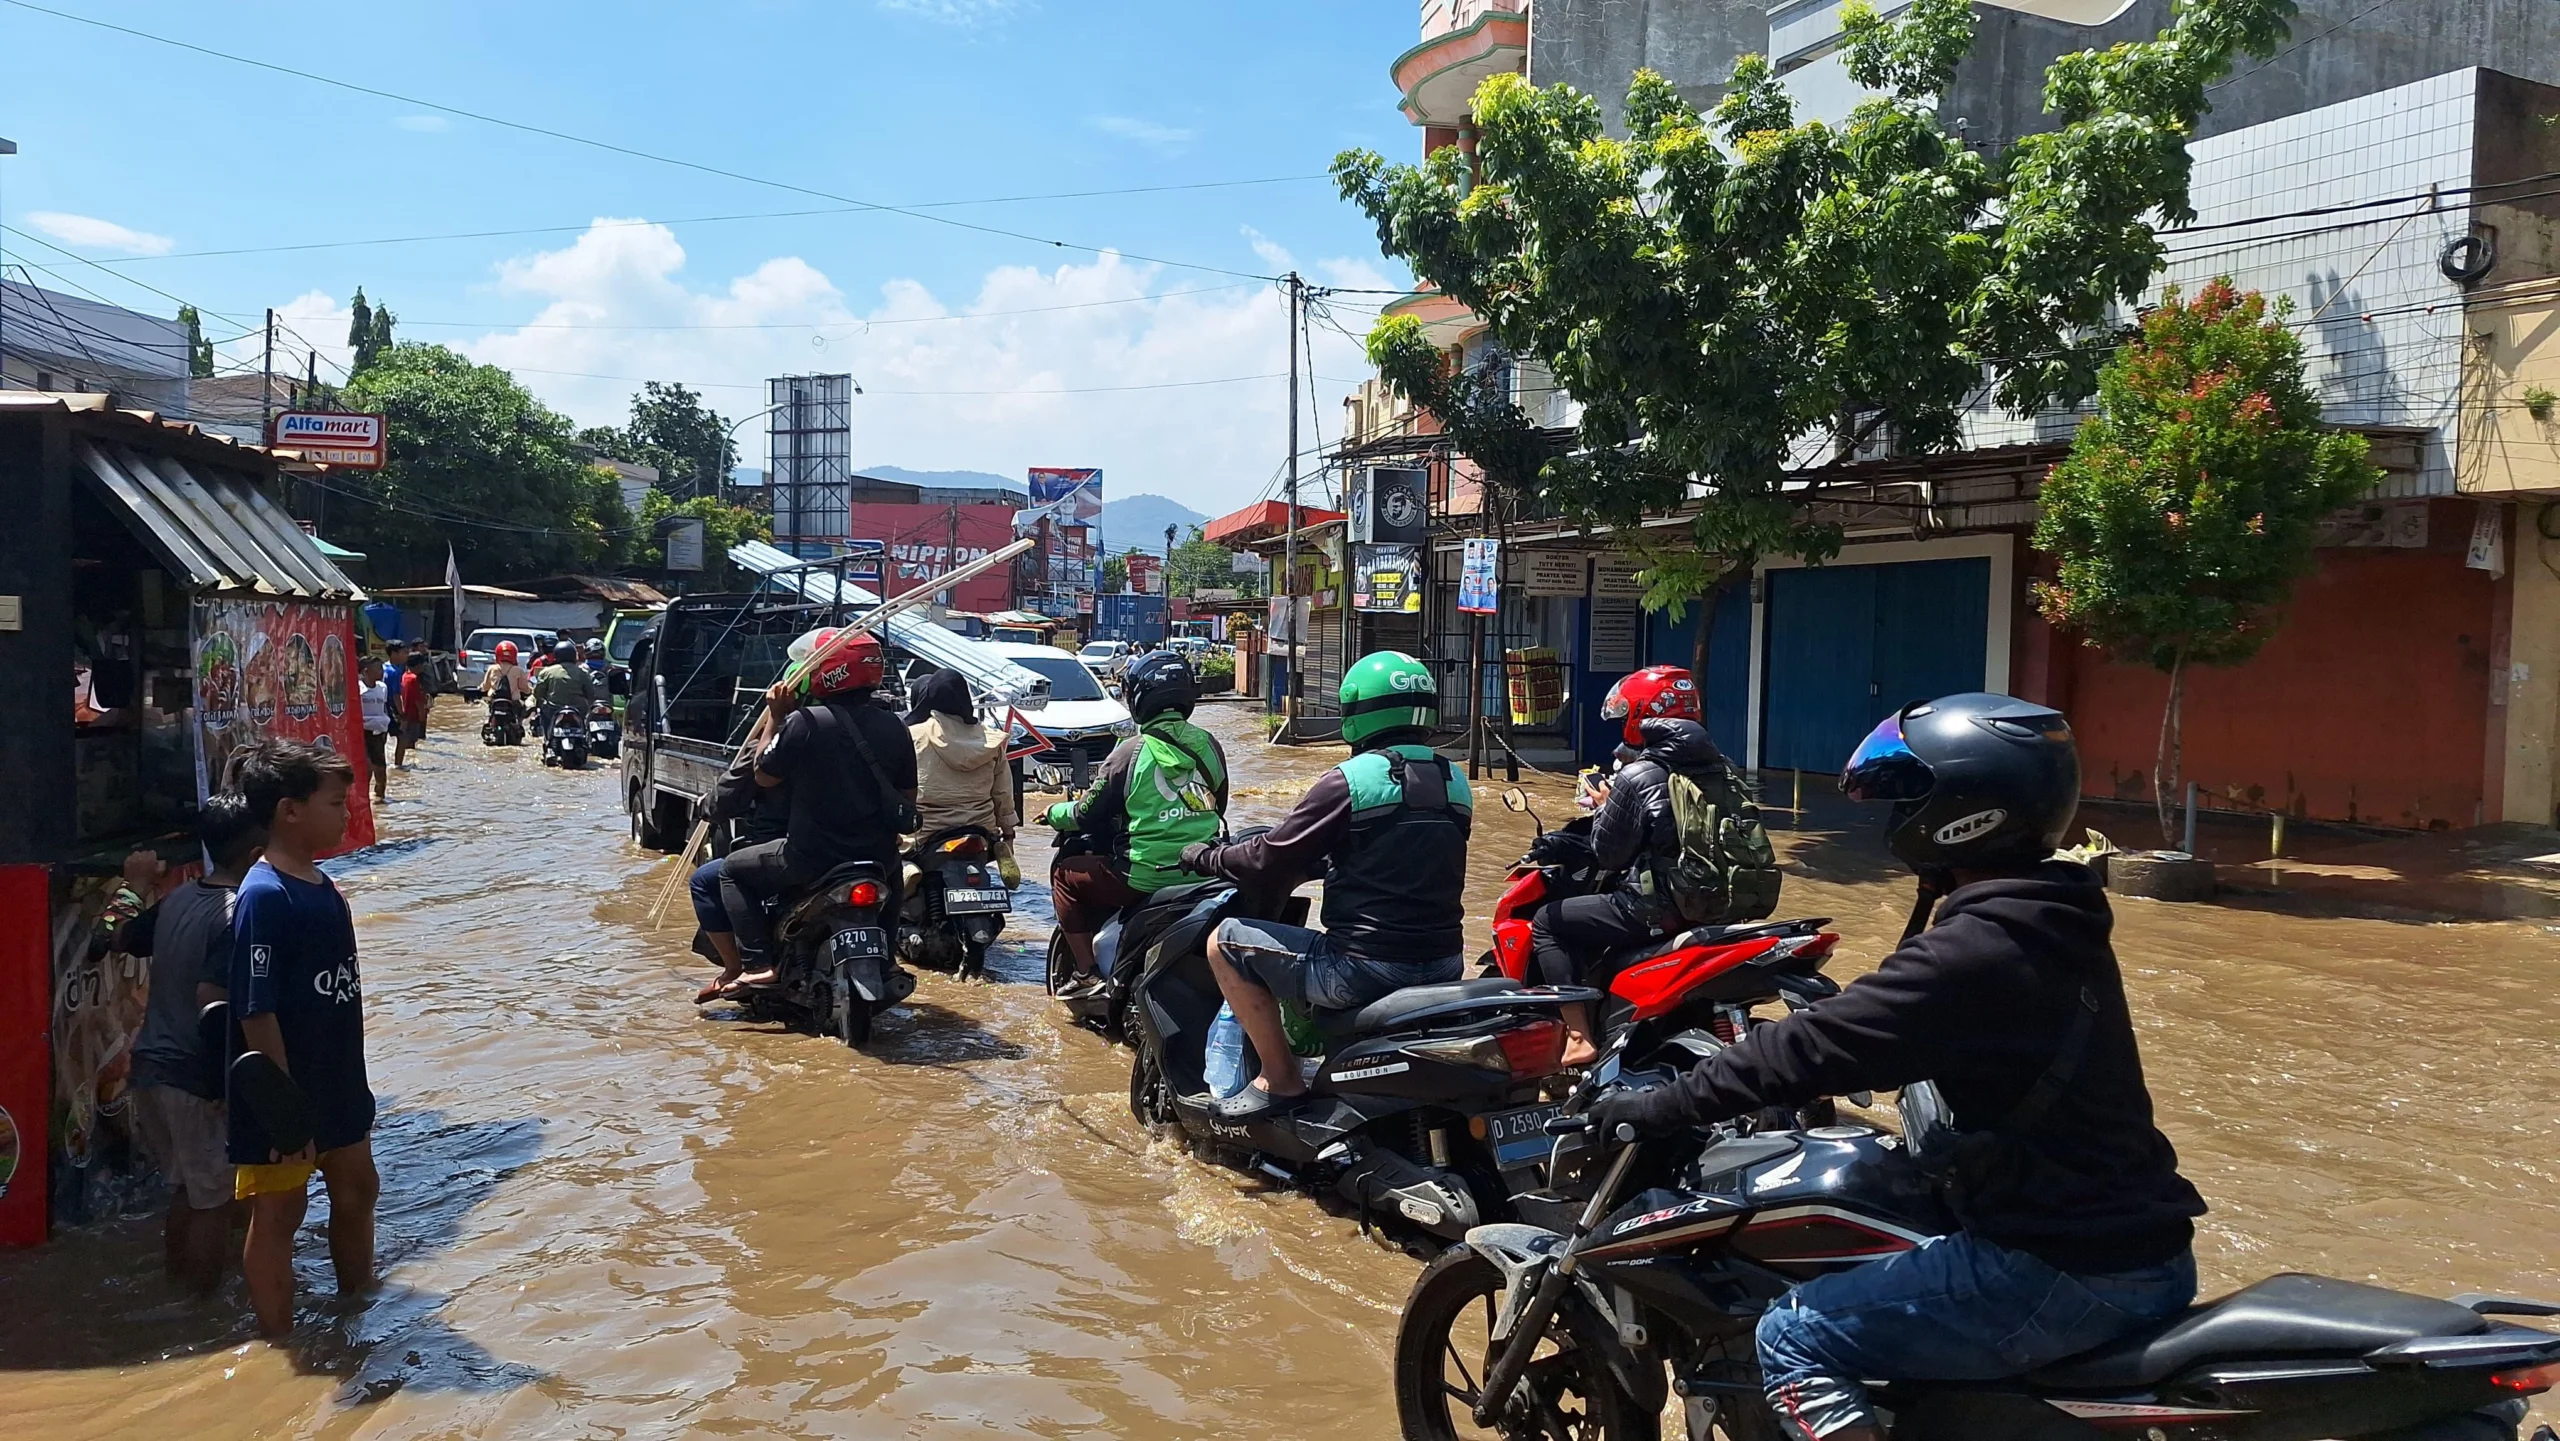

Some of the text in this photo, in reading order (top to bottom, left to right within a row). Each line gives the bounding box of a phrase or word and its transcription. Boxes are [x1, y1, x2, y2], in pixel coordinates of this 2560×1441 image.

[285, 416, 371, 433] Alfamart
[891, 544, 988, 562] NIPPON
[1367, 555, 1409, 576] BARBERSHOP
[821, 663, 850, 688] NHK
[1390, 671, 1437, 692] Grab
[1086, 777, 1108, 804] gojek
[1942, 811, 1996, 840] INK
[831, 931, 867, 951] D 3270
[1209, 1119, 1251, 1138] gojek
[1493, 1119, 1504, 1139] D
[1510, 1112, 1542, 1135] 2590
[1752, 1177, 1801, 1193] HONDA
[1612, 1199, 1709, 1235] CB150R
